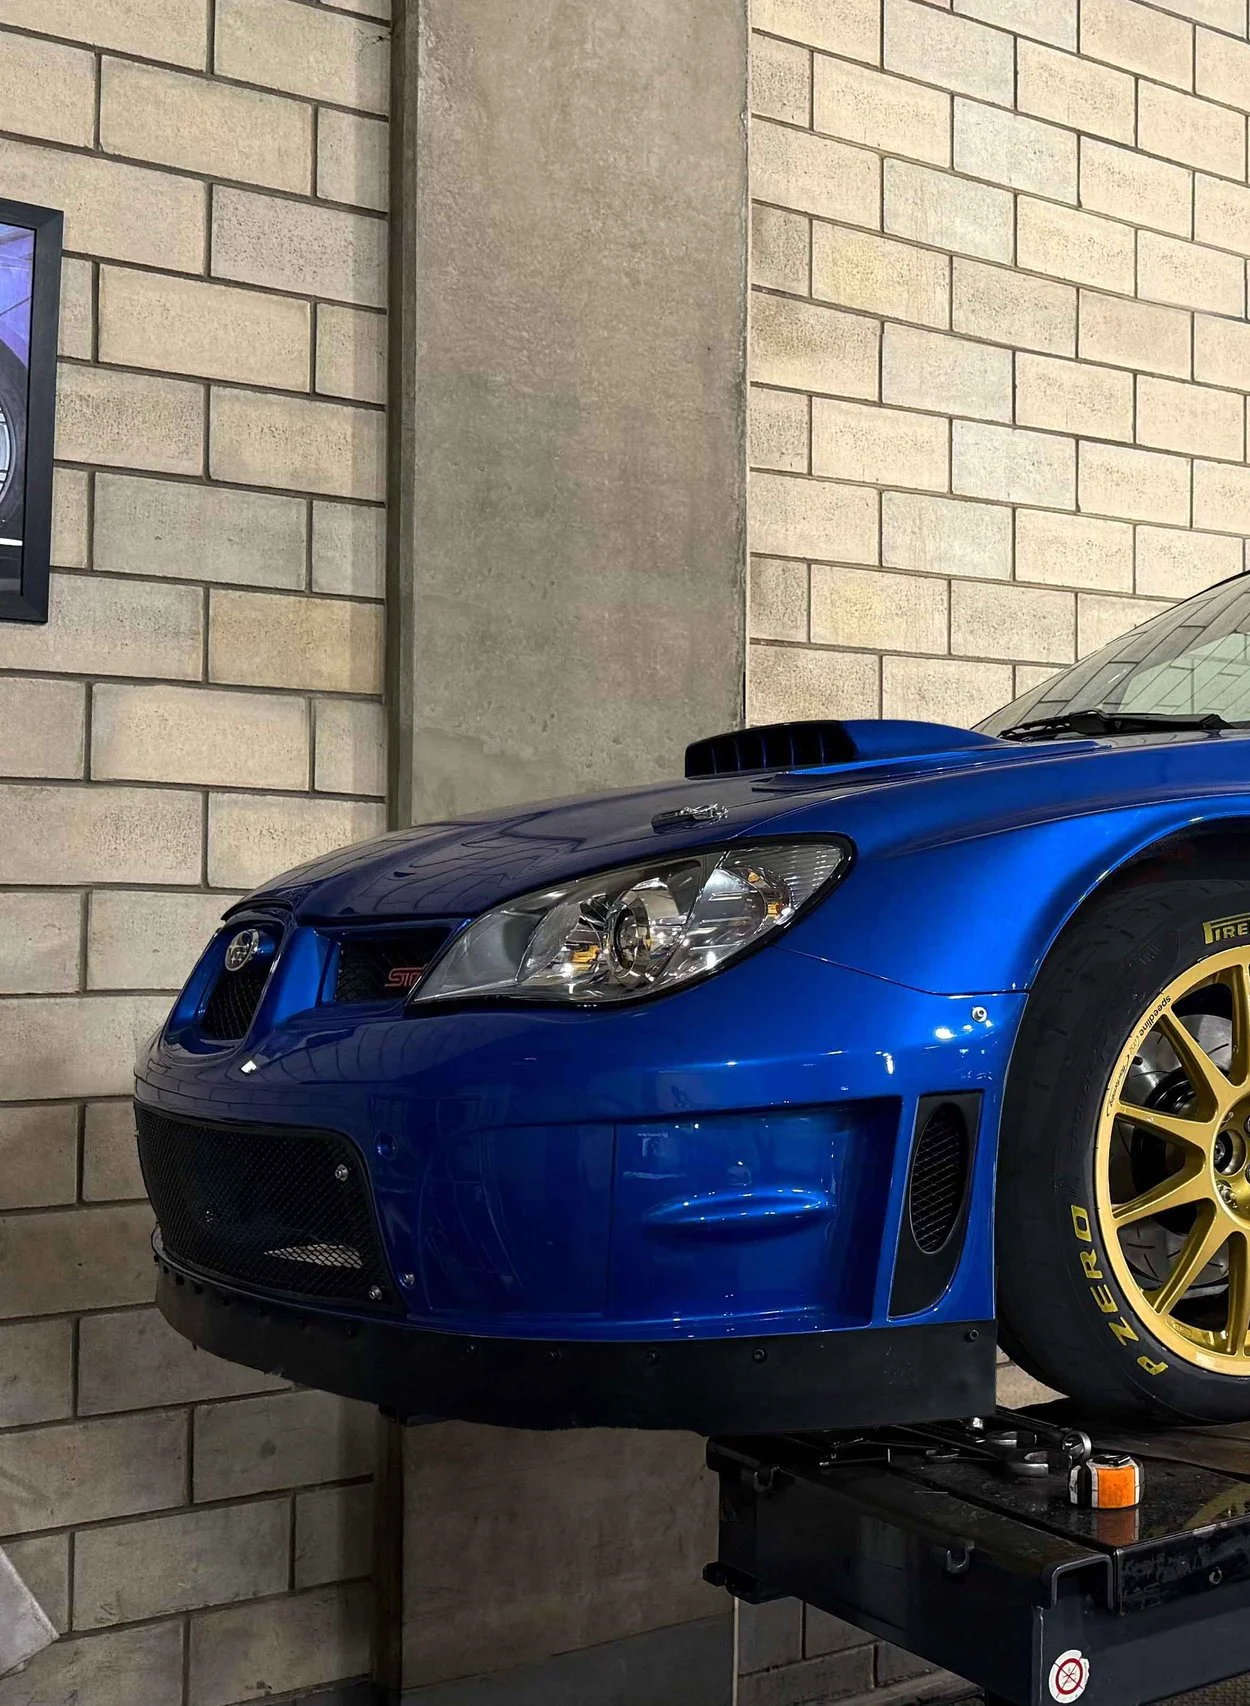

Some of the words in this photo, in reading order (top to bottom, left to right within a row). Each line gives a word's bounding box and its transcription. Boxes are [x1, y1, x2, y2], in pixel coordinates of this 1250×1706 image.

[1140, 995, 1172, 1036] speedline
[1070, 1204, 1140, 1346] ZERO
[1136, 1355, 1169, 1376] P
